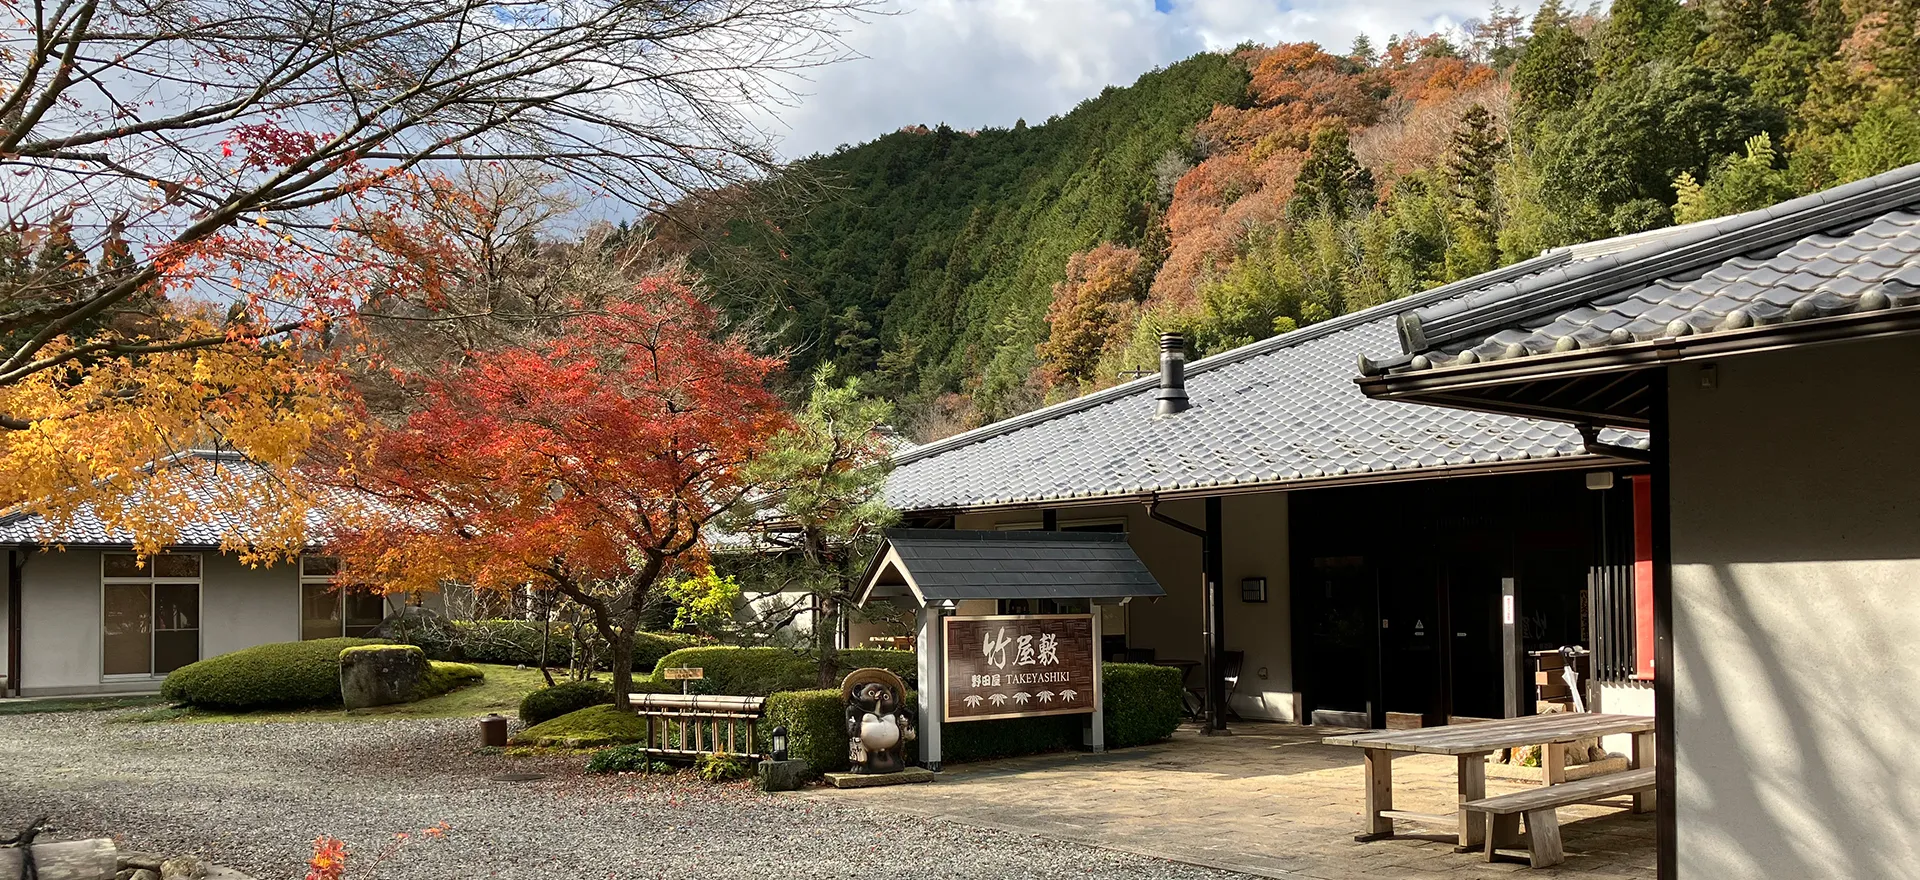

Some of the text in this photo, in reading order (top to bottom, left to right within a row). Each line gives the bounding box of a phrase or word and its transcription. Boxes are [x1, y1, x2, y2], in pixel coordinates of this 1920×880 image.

[982, 626, 1059, 669] 竹屋敷
[971, 671, 1070, 687] 野田屋 TAKEYASHIKI
